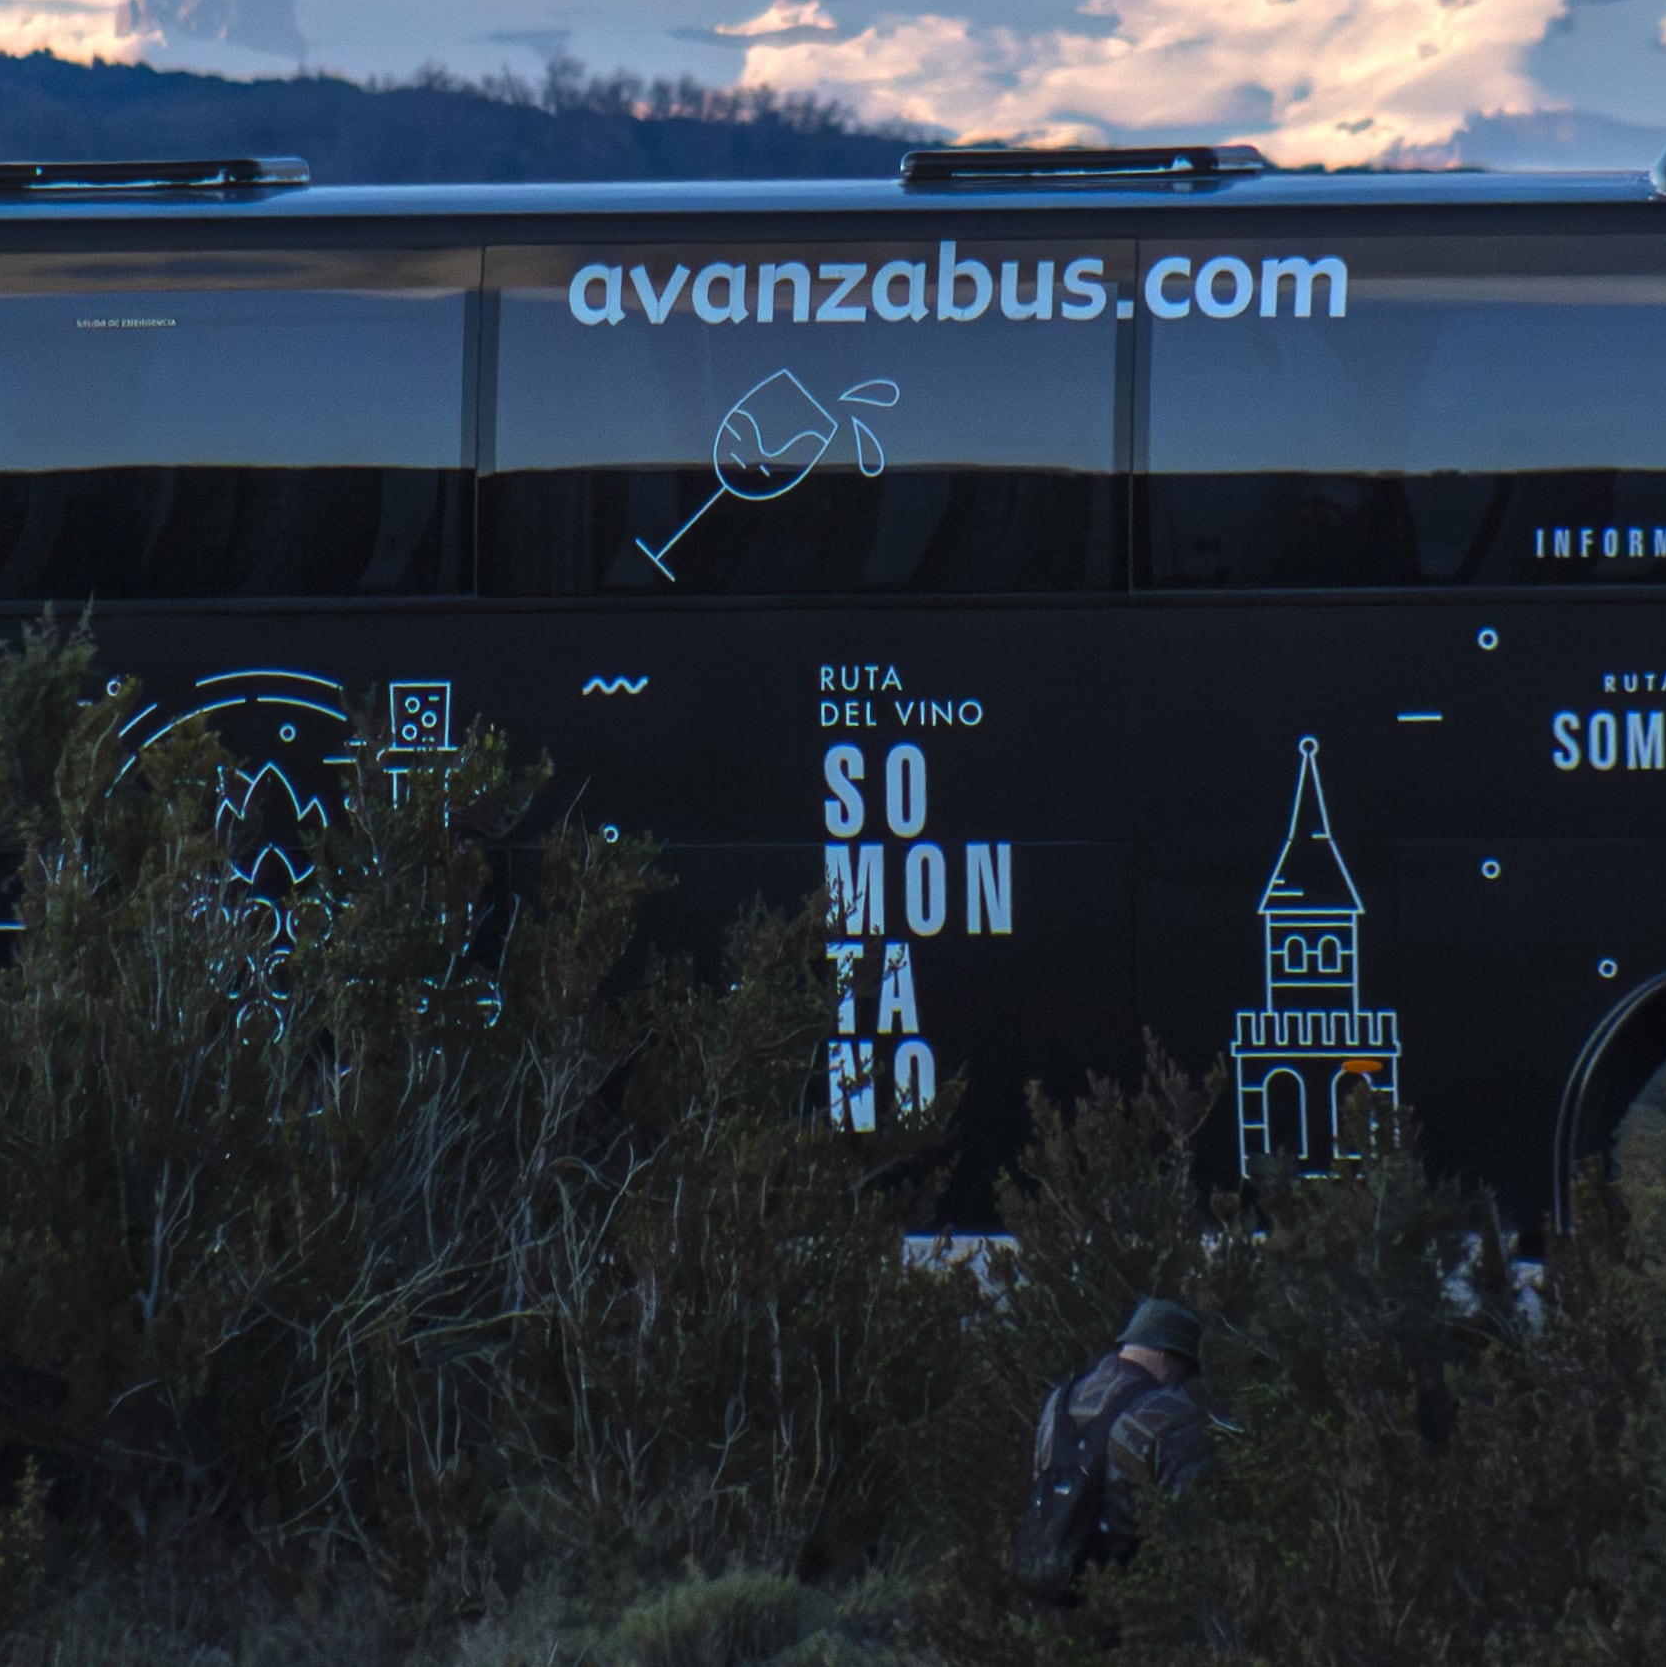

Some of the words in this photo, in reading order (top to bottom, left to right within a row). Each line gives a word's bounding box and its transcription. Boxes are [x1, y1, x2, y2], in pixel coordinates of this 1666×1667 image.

[568, 240, 1349, 325] avanzabus.com
[820, 664, 902, 691] RUTA
[820, 700, 877, 726] DEL
[894, 700, 983, 726] VINO
[824, 743, 926, 838] SO
[825, 841, 1013, 936] MON
[826, 941, 920, 1034] TA
